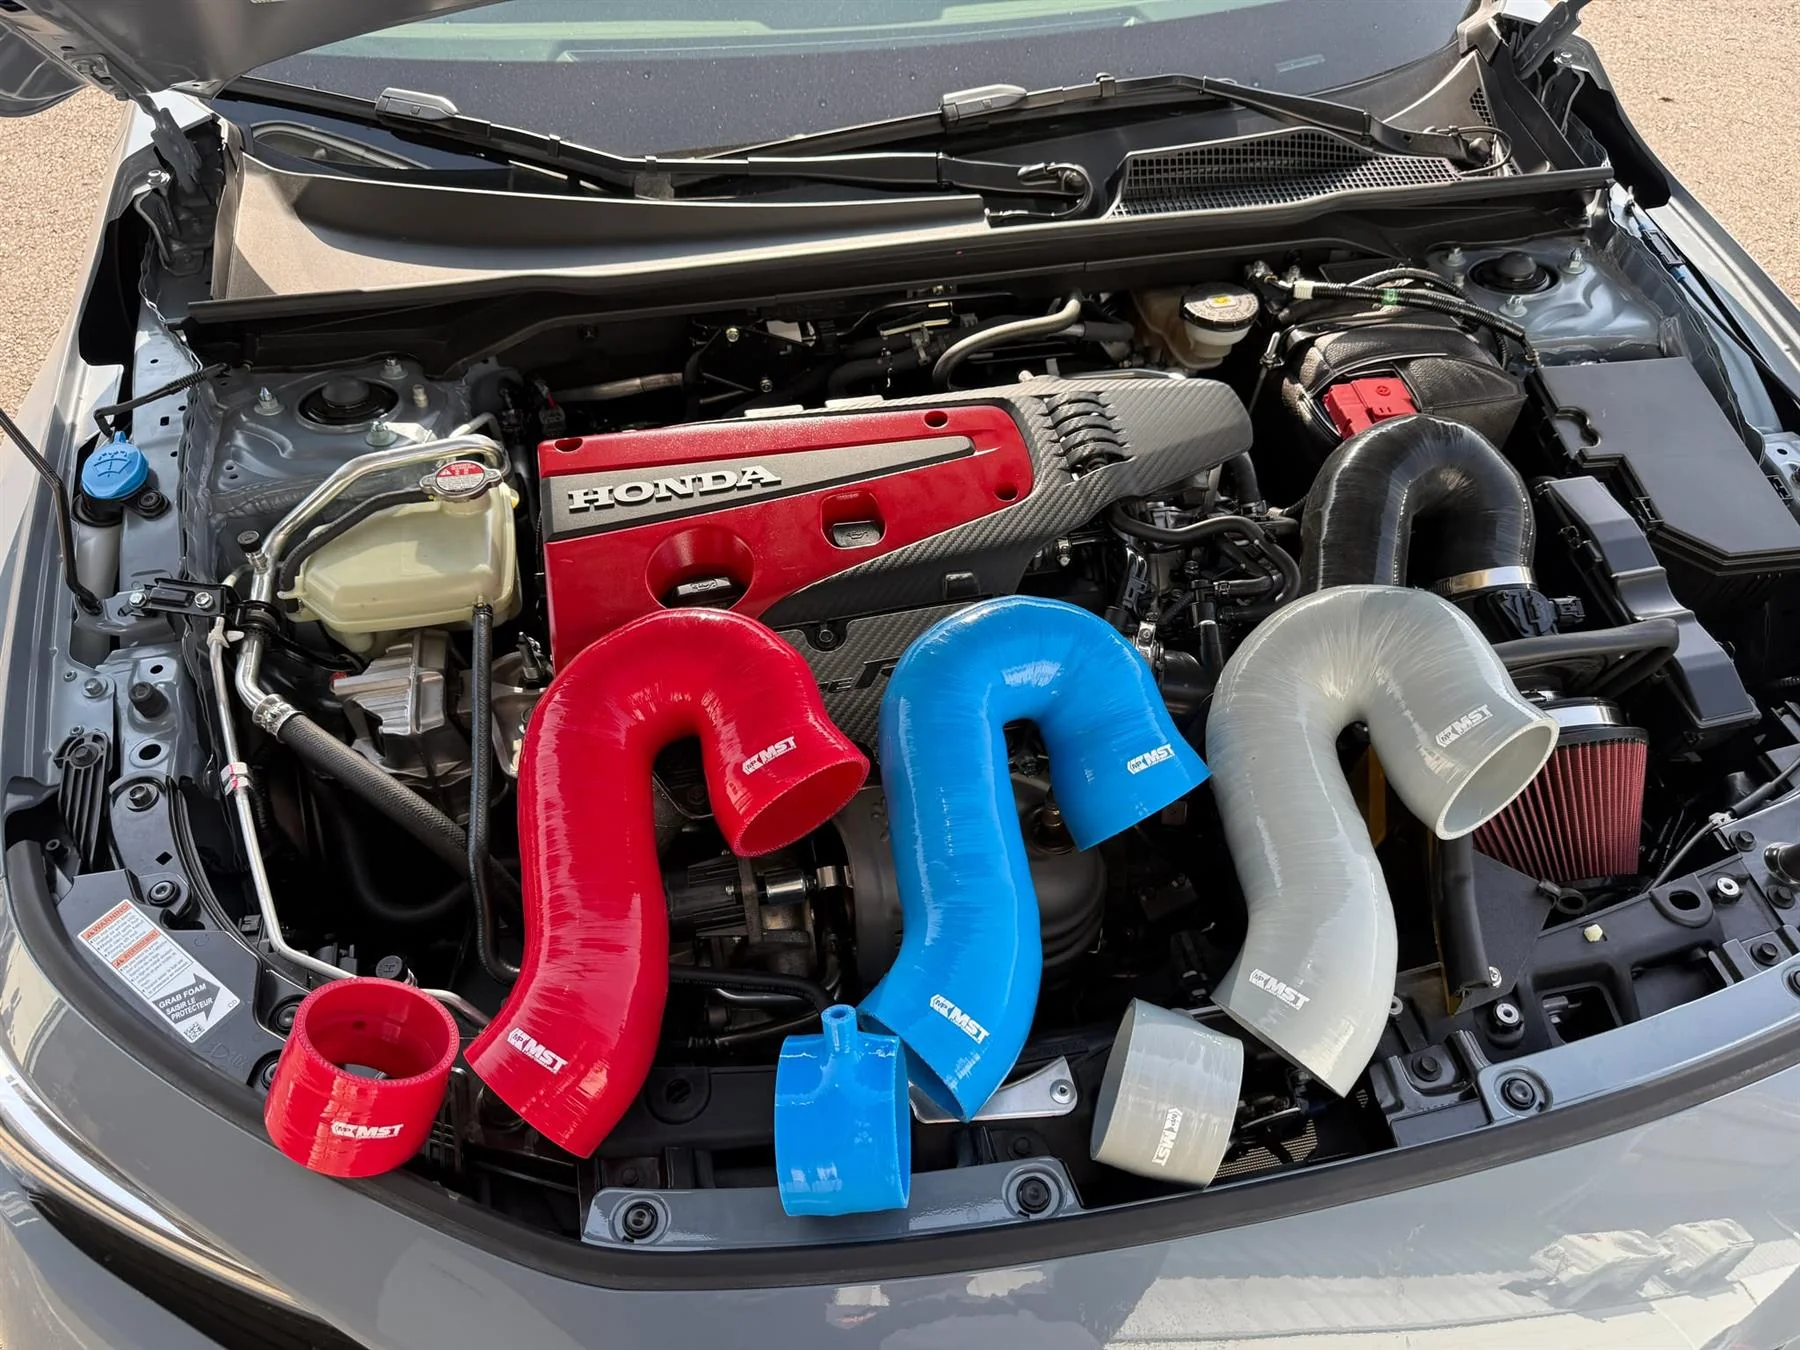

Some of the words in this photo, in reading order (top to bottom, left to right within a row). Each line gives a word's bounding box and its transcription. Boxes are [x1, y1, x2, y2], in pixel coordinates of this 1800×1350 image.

[567, 465, 782, 514] HONDA
[1451, 704, 1493, 734] MST
[760, 736, 797, 763] MST
[1143, 743, 1175, 766] MST
[159, 993, 182, 1009] GRAB
[183, 983, 207, 998] FOAM
[166, 1000, 187, 1015] SAISIR
[187, 996, 197, 1006] LE
[1264, 977, 1311, 1009] MST
[170, 997, 214, 1020] PROTECTEUR
[948, 1006, 990, 1043] MST
[522, 1037, 568, 1072] MST
[356, 1123, 404, 1138] MST
[1152, 1130, 1176, 1166] MST
